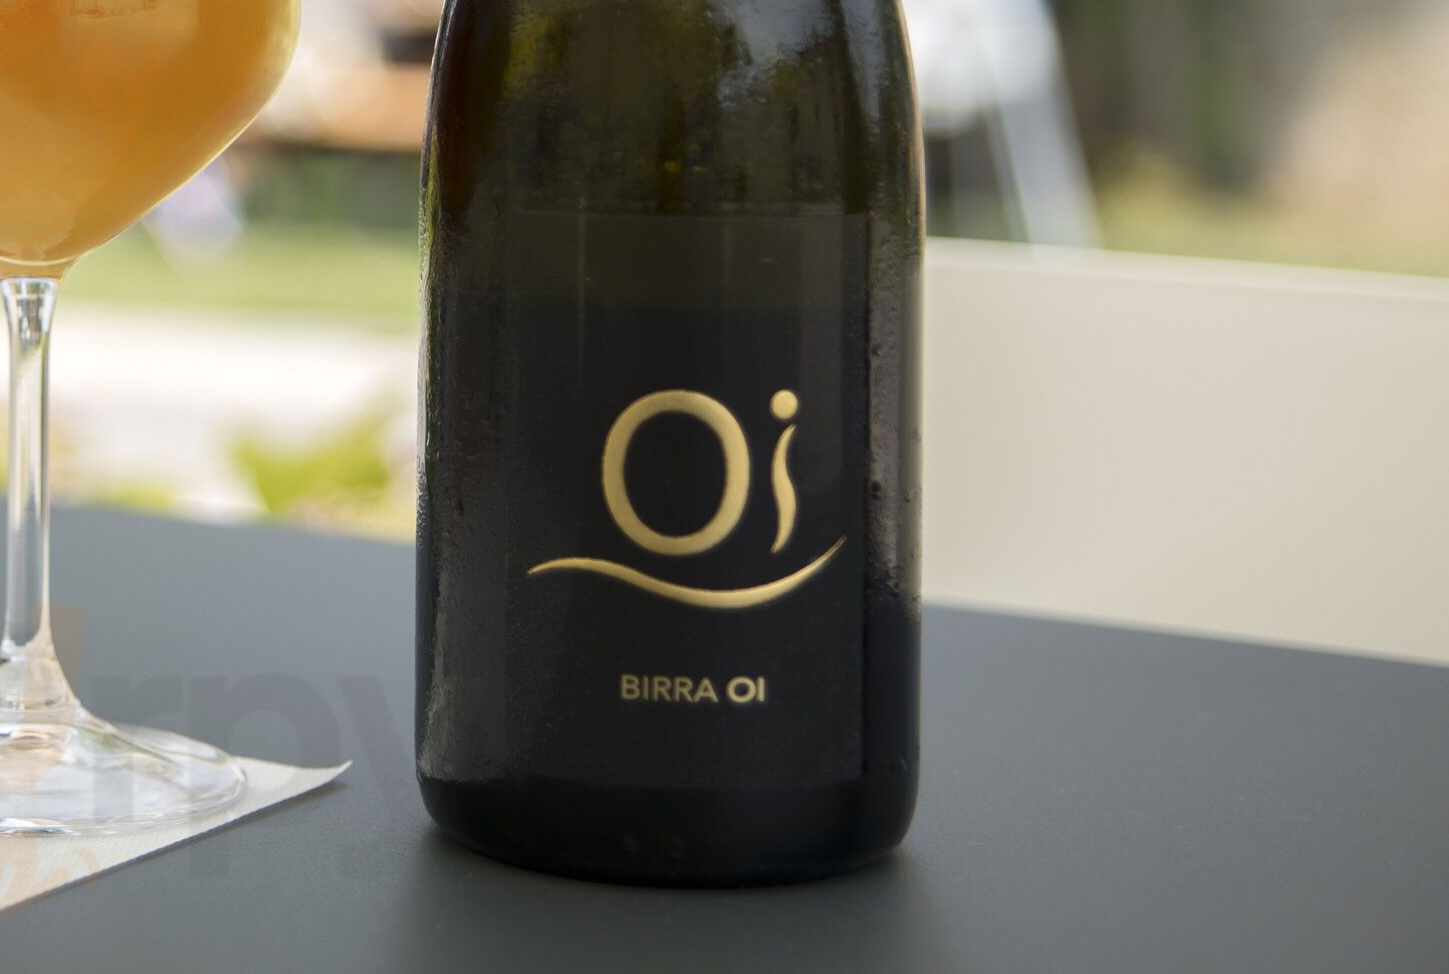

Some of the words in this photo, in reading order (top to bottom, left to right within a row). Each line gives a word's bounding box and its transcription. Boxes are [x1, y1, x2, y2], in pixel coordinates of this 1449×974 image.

[601, 388, 800, 556] Oi
[620, 674, 719, 703] BIRRA
[726, 676, 766, 704] OI
